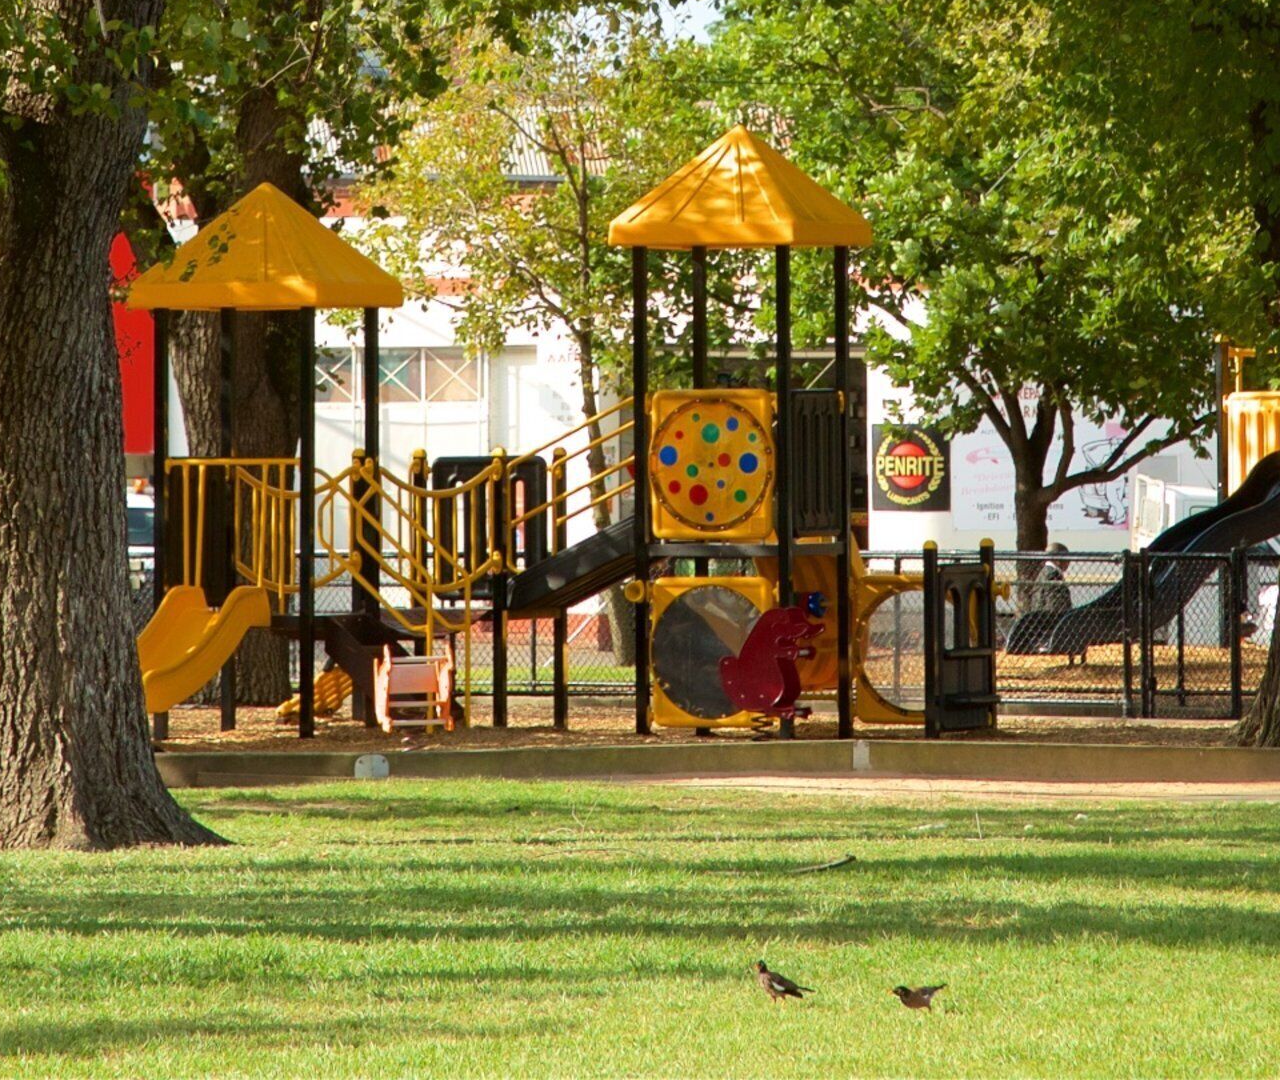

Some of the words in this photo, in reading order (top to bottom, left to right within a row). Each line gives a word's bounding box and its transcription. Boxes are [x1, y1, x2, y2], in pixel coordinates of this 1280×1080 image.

[876, 456, 944, 477] PENRITE
[976, 502, 1005, 512] Ignition
[987, 512, 1000, 521] EFI
